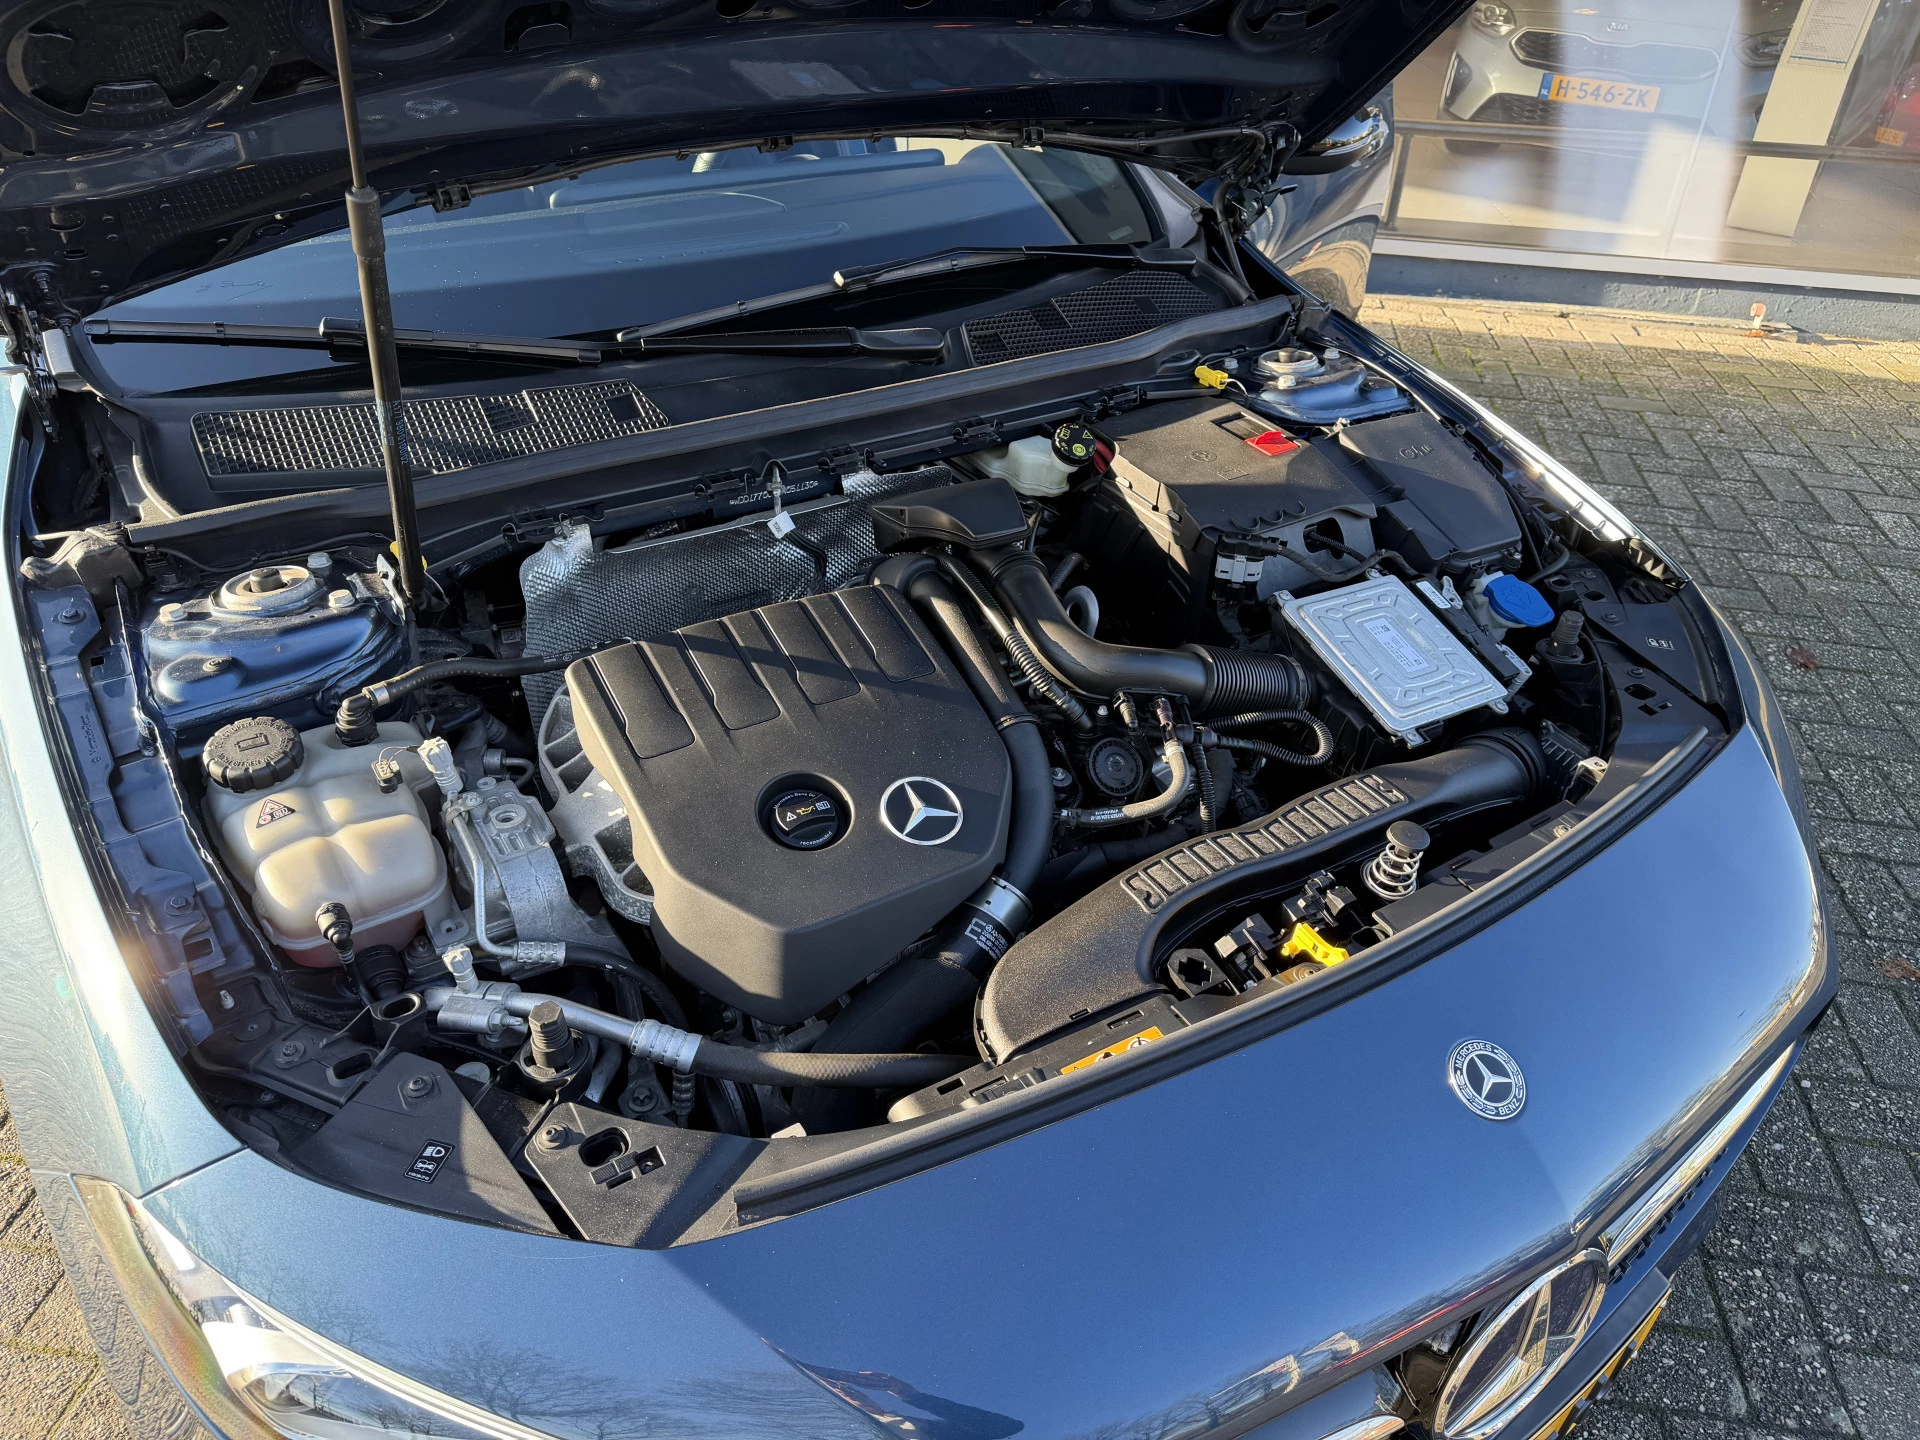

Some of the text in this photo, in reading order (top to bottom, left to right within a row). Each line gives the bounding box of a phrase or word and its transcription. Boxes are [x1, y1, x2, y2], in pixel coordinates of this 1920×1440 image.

[1556, 79, 1650, 108] H-546-ZK
[800, 831, 833, 846] recommended
[1455, 1042, 1492, 1069] MERCEDES
[1498, 1098, 1520, 1115] BENZ
